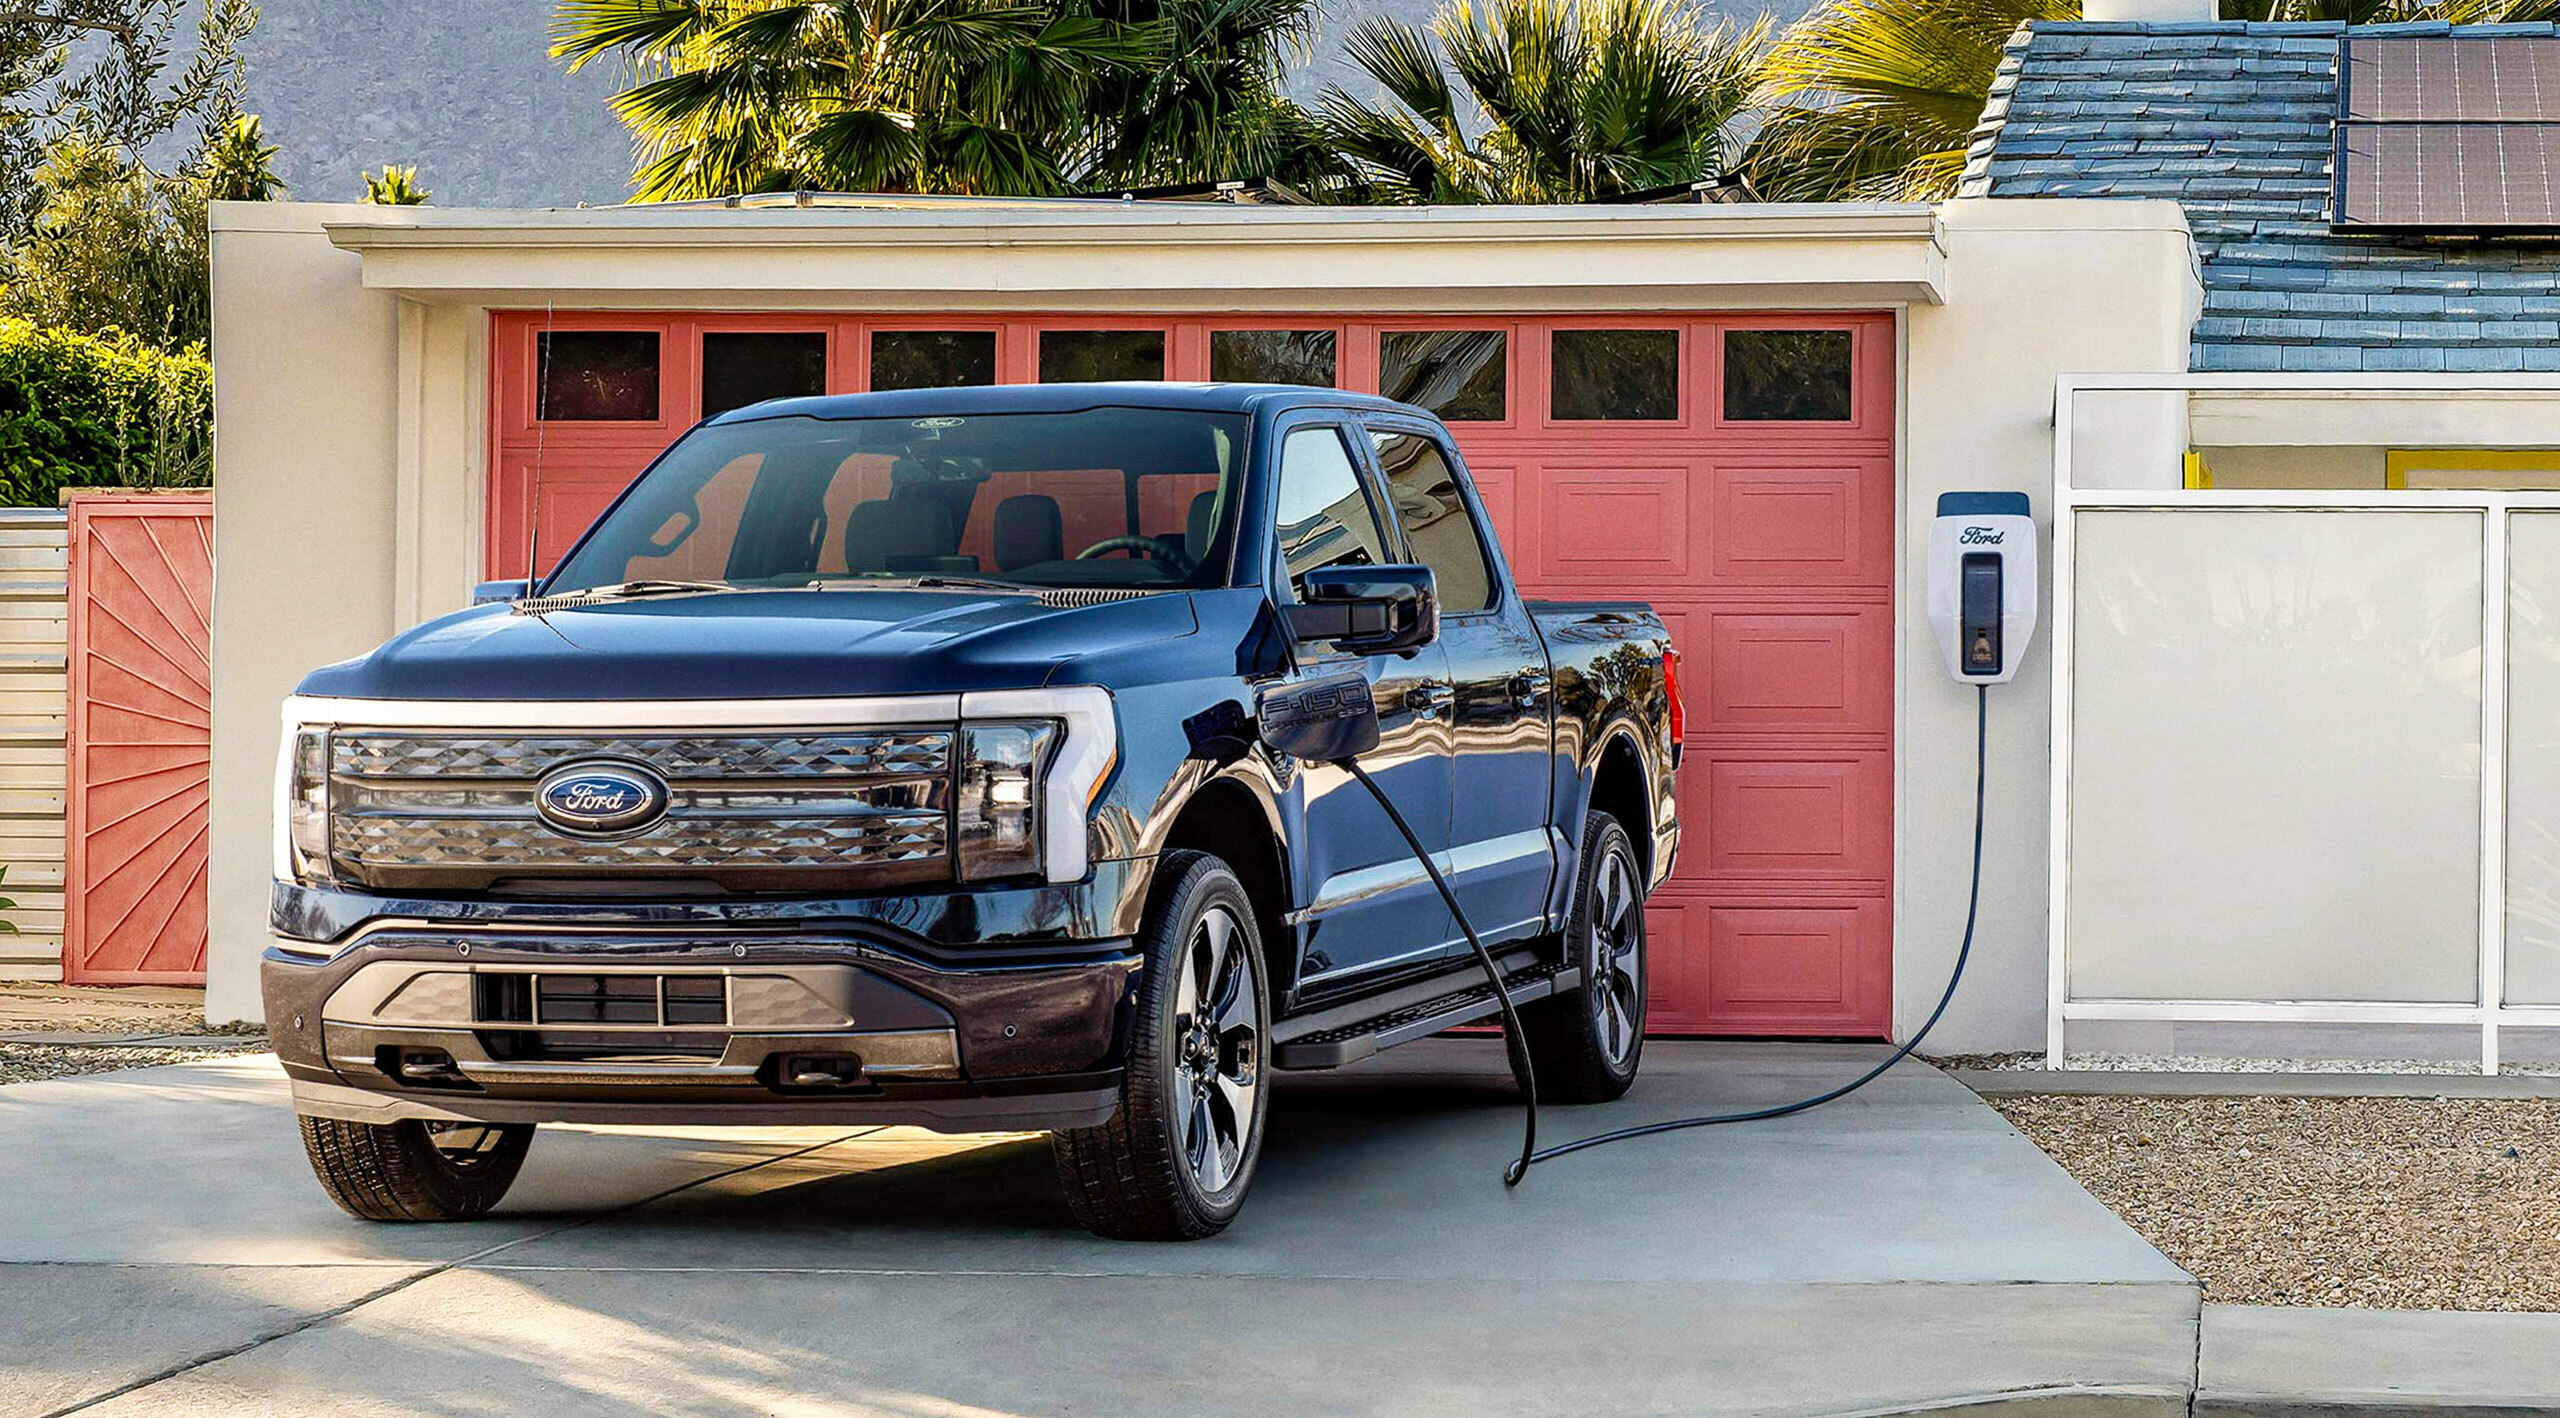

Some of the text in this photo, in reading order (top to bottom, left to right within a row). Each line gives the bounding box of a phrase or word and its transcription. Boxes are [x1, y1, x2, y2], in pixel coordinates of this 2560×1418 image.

[1960, 526, 2004, 545] Ford
[1260, 681, 1369, 722] F-150
[565, 783, 625, 809] Ford
